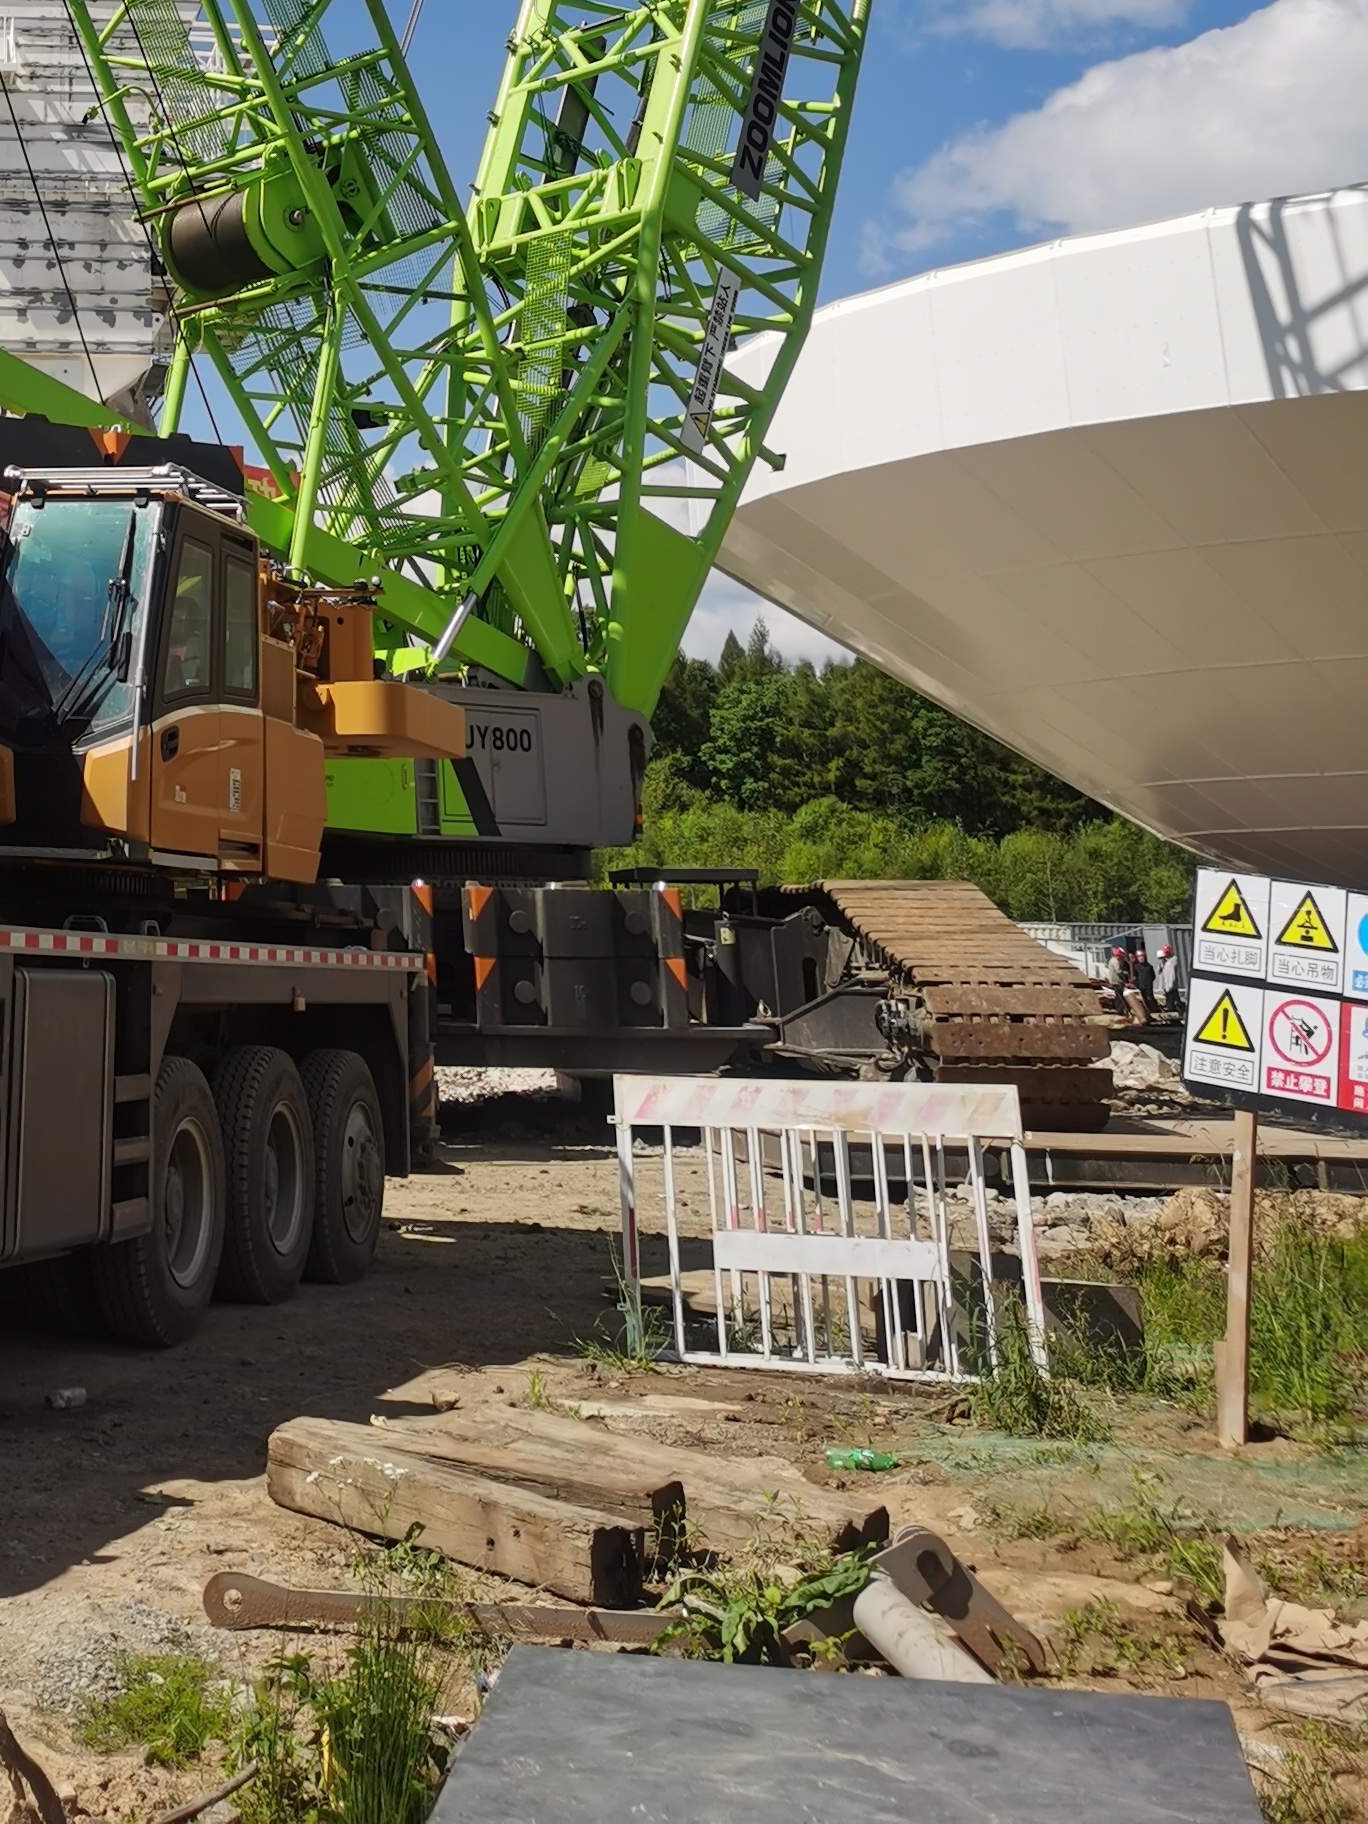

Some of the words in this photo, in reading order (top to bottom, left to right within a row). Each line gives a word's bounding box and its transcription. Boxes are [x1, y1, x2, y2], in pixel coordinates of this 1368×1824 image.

[1204, 944, 1258, 967] 当心扎脚
[1278, 958, 1335, 981] 当心吊物
[1194, 1055, 1250, 1081] 注意安全
[1270, 1070, 1328, 1095] 禁止攀登
